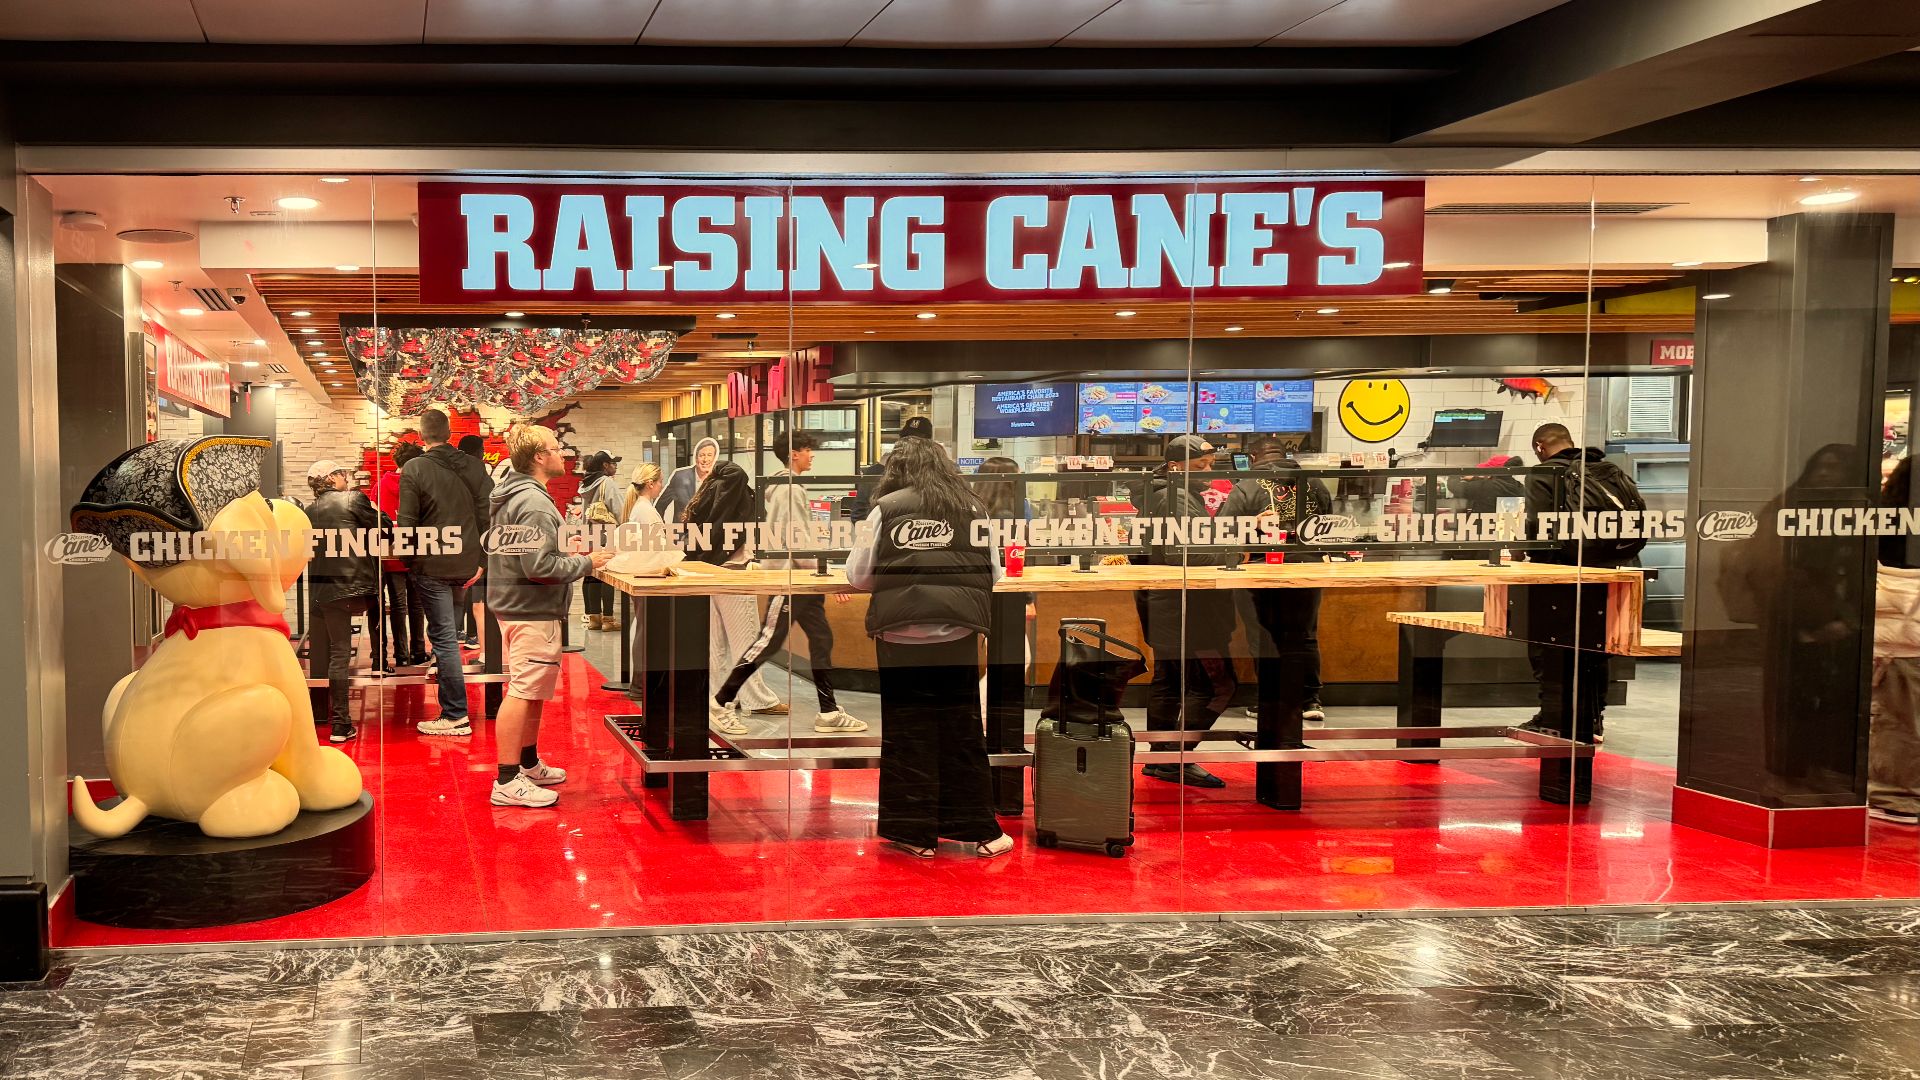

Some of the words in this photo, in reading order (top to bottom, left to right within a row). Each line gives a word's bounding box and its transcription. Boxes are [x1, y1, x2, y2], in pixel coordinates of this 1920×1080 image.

[460, 193, 945, 292] RAISING
[985, 187, 1385, 290] CANE'S
[1660, 345, 1694, 360] MOB
[727, 364, 763, 418] ONE
[557, 522, 712, 552] CHICKEN
[722, 520, 875, 551] FINGERS
[893, 519, 952, 547] Cane's
[970, 517, 1120, 547] CHICKEN
[1130, 515, 1280, 546] FINGERS
[1300, 514, 1358, 542] Cane's
[1376, 513, 1527, 542] CHICKEN
[1537, 510, 1685, 540] FINGERS
[1699, 511, 1756, 538] Cane's
[1777, 507, 1920, 537] CHICKEN
[48, 533, 110, 562] Cane's
[130, 530, 291, 561] CHICKEN
[302, 526, 463, 558] FINGERS
[483, 525, 543, 553] Cane's
